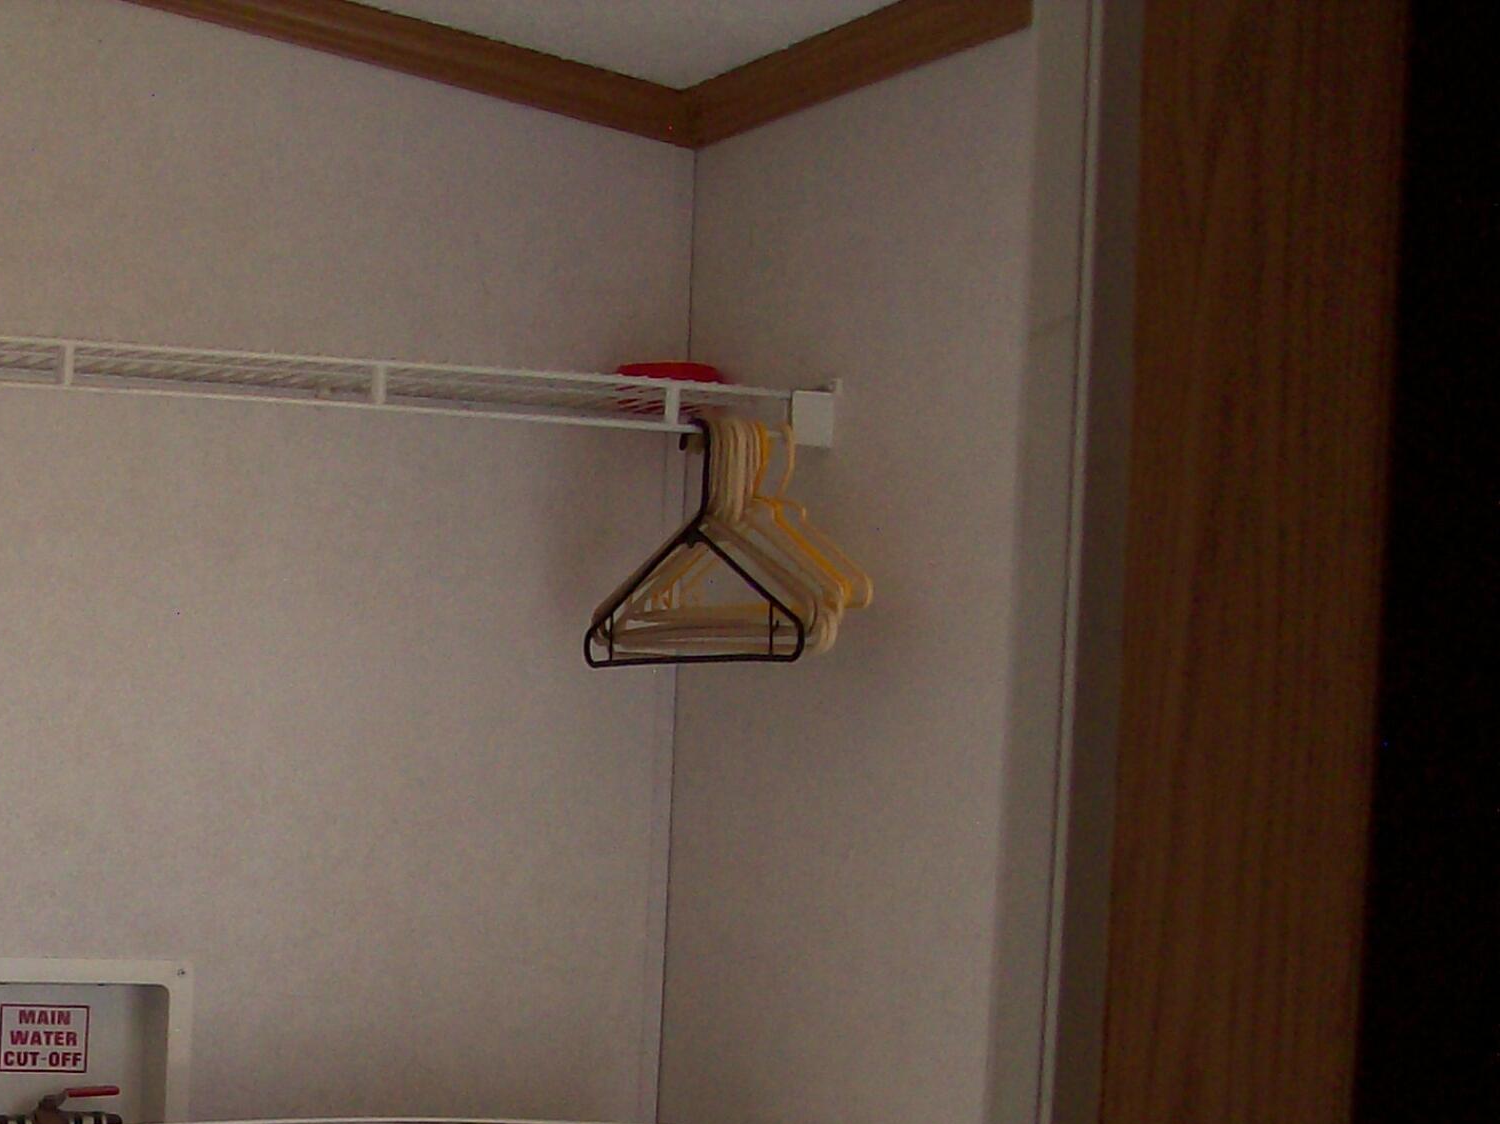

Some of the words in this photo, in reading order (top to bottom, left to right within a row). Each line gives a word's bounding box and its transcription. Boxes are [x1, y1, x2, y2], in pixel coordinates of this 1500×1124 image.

[18, 1009, 71, 1025] MAIN
[10, 1030, 77, 1046] WATER
[3, 1051, 82, 1067] CUT-OFF
